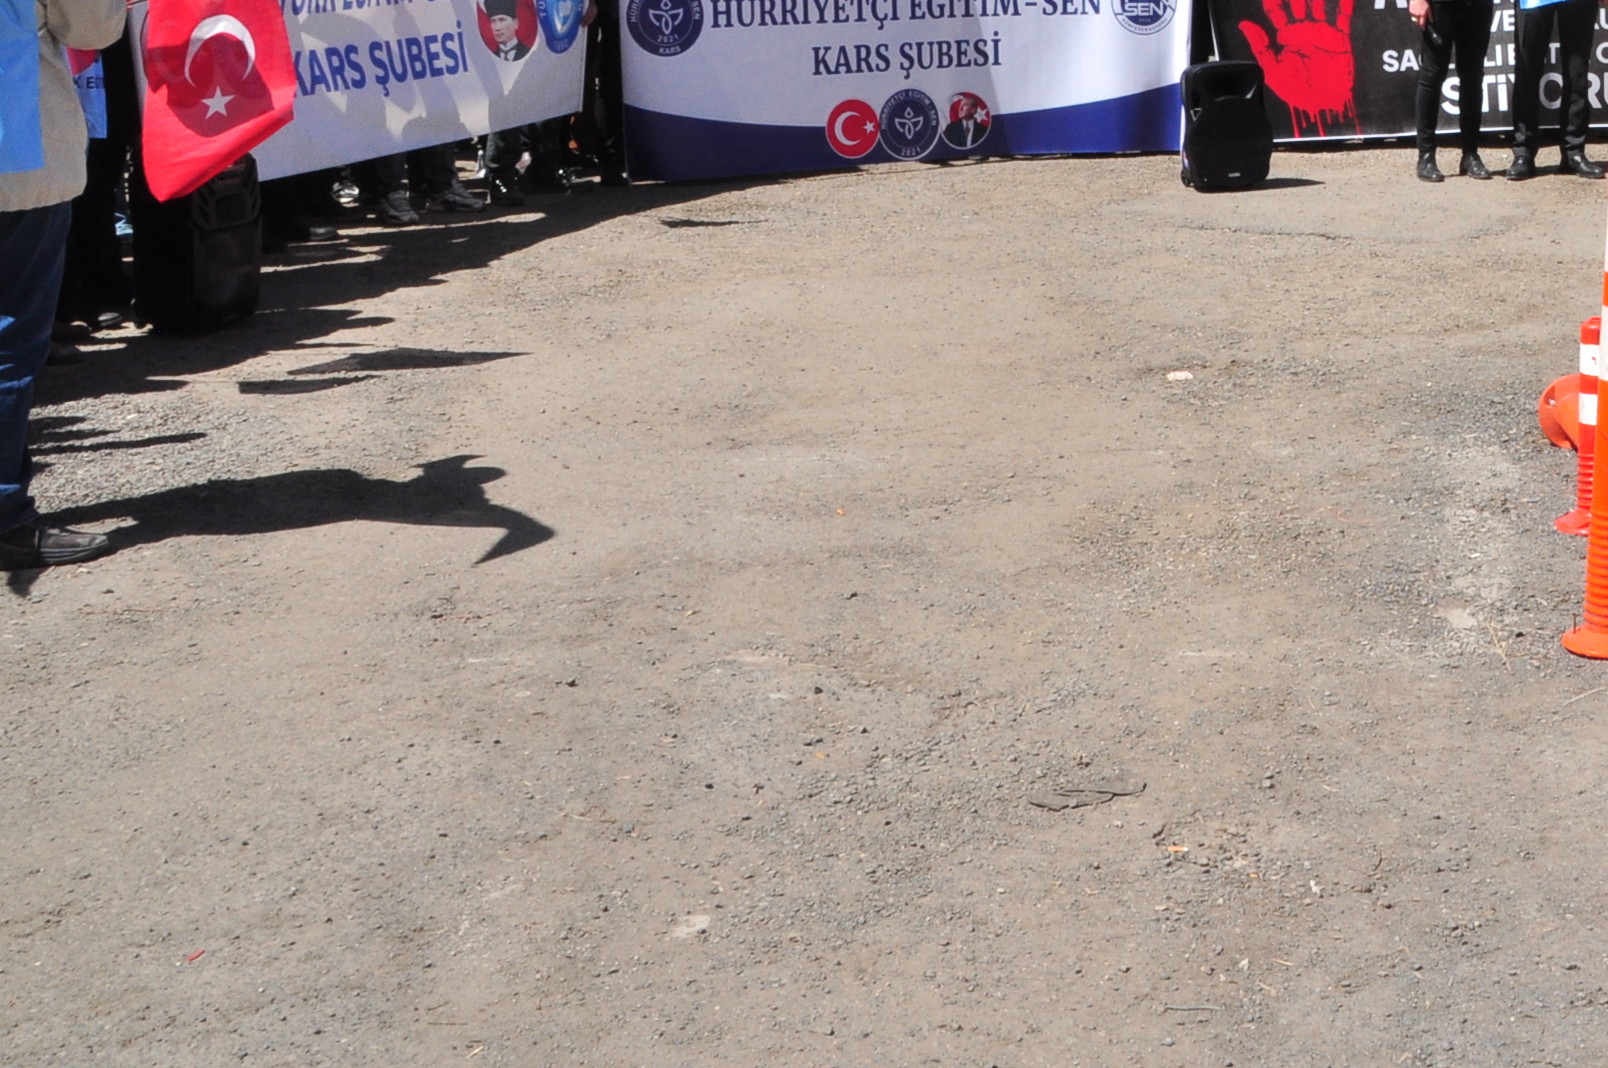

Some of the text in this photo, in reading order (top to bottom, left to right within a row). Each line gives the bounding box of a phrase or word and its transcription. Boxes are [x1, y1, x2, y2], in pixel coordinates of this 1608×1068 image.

[1123, 1, 1164, 17] SEN
[368, 20, 469, 97] ŞUBESİ
[812, 30, 1002, 79] KARS ŞUBESİ
